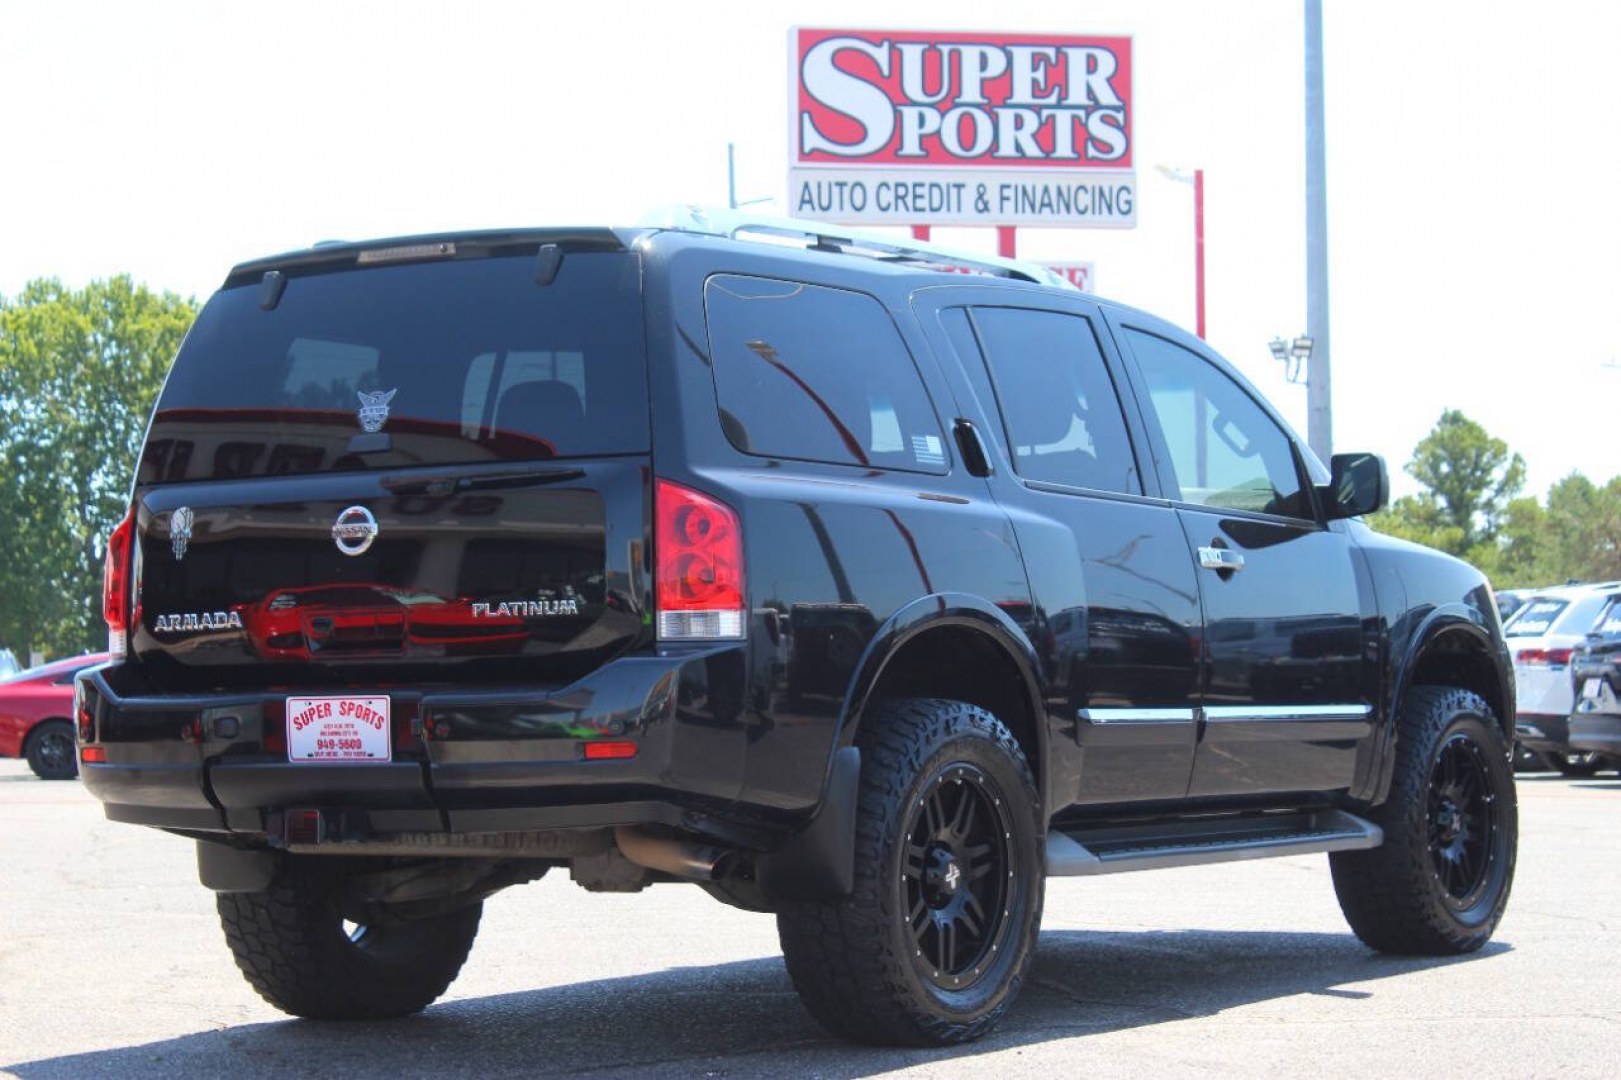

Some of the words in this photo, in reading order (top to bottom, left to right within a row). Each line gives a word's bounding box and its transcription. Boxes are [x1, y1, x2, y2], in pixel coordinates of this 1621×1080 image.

[801, 36, 1124, 158] SUPER
[799, 181, 867, 213] AUTO
[875, 181, 966, 214] CREDIT
[974, 186, 990, 214] &
[999, 183, 1133, 216] FINANCING
[335, 524, 373, 536] NISSAN
[153, 610, 243, 632] ARMADA
[471, 599, 578, 618] PLATINUM
[293, 702, 333, 731] SUPER
[339, 701, 385, 730] SPORTS
